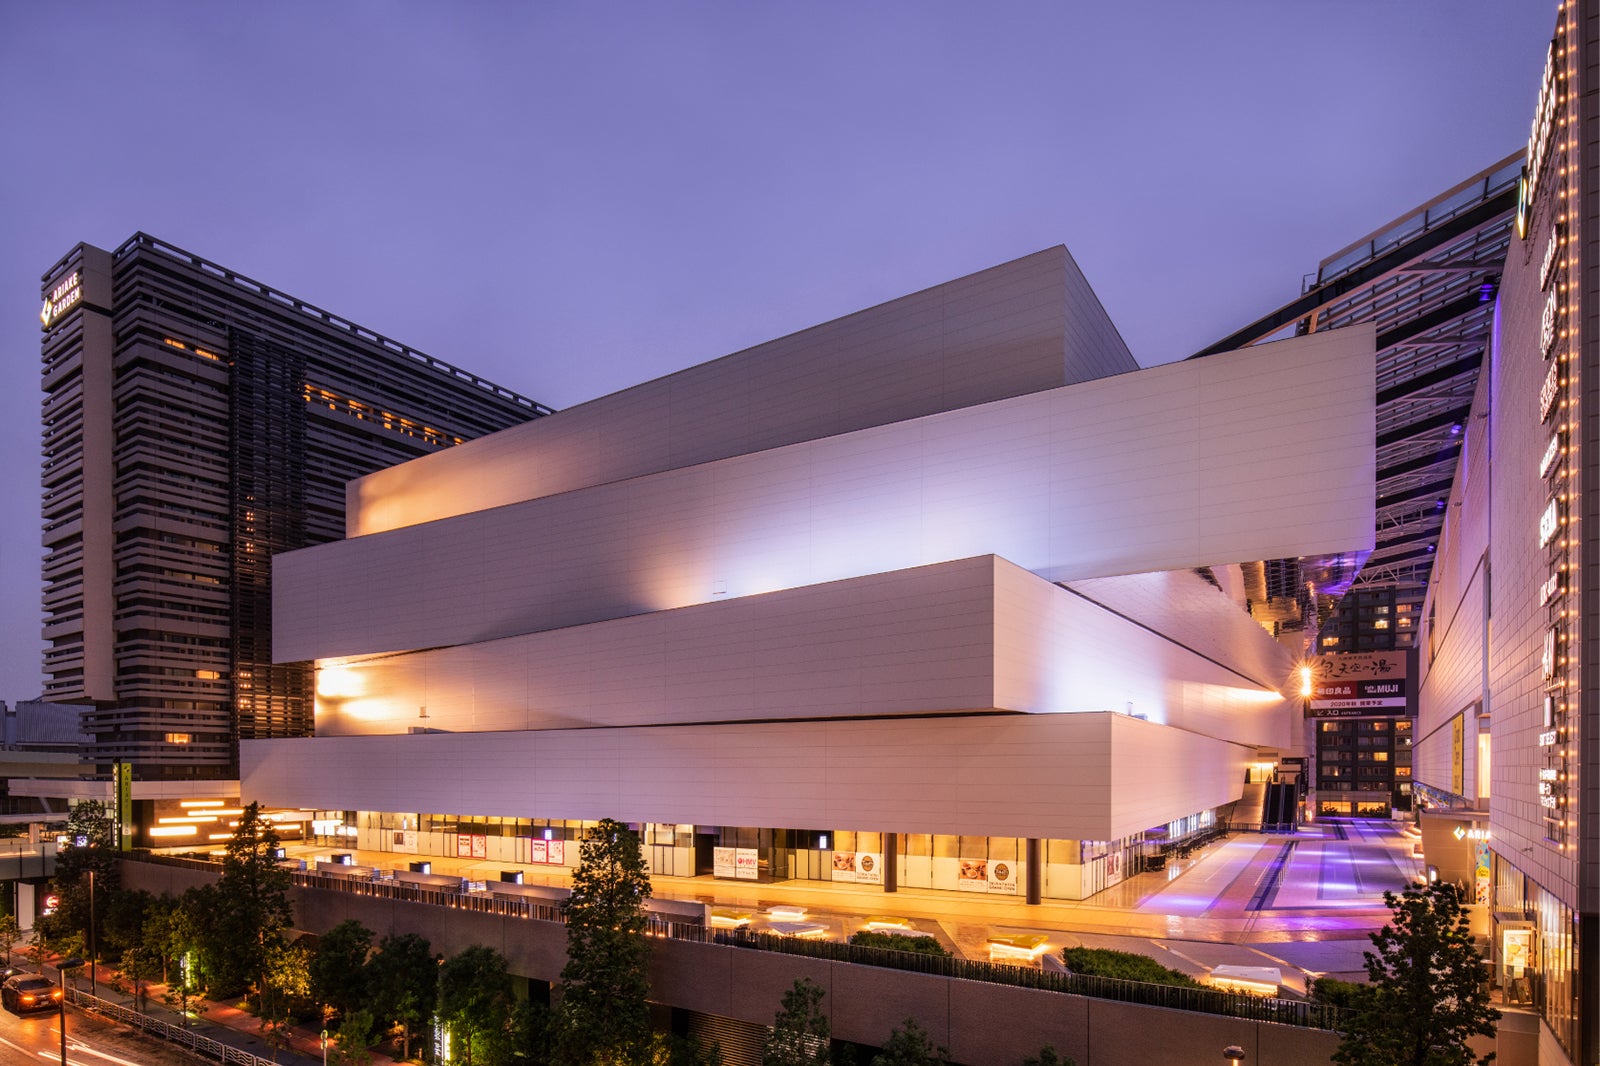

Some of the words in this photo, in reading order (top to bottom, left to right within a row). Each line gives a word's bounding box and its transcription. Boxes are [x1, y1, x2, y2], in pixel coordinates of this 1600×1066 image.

[52, 286, 80, 317] GARDEN
[53, 271, 78, 302] ARIAKE
[1377, 684, 1399, 693] MUJI
